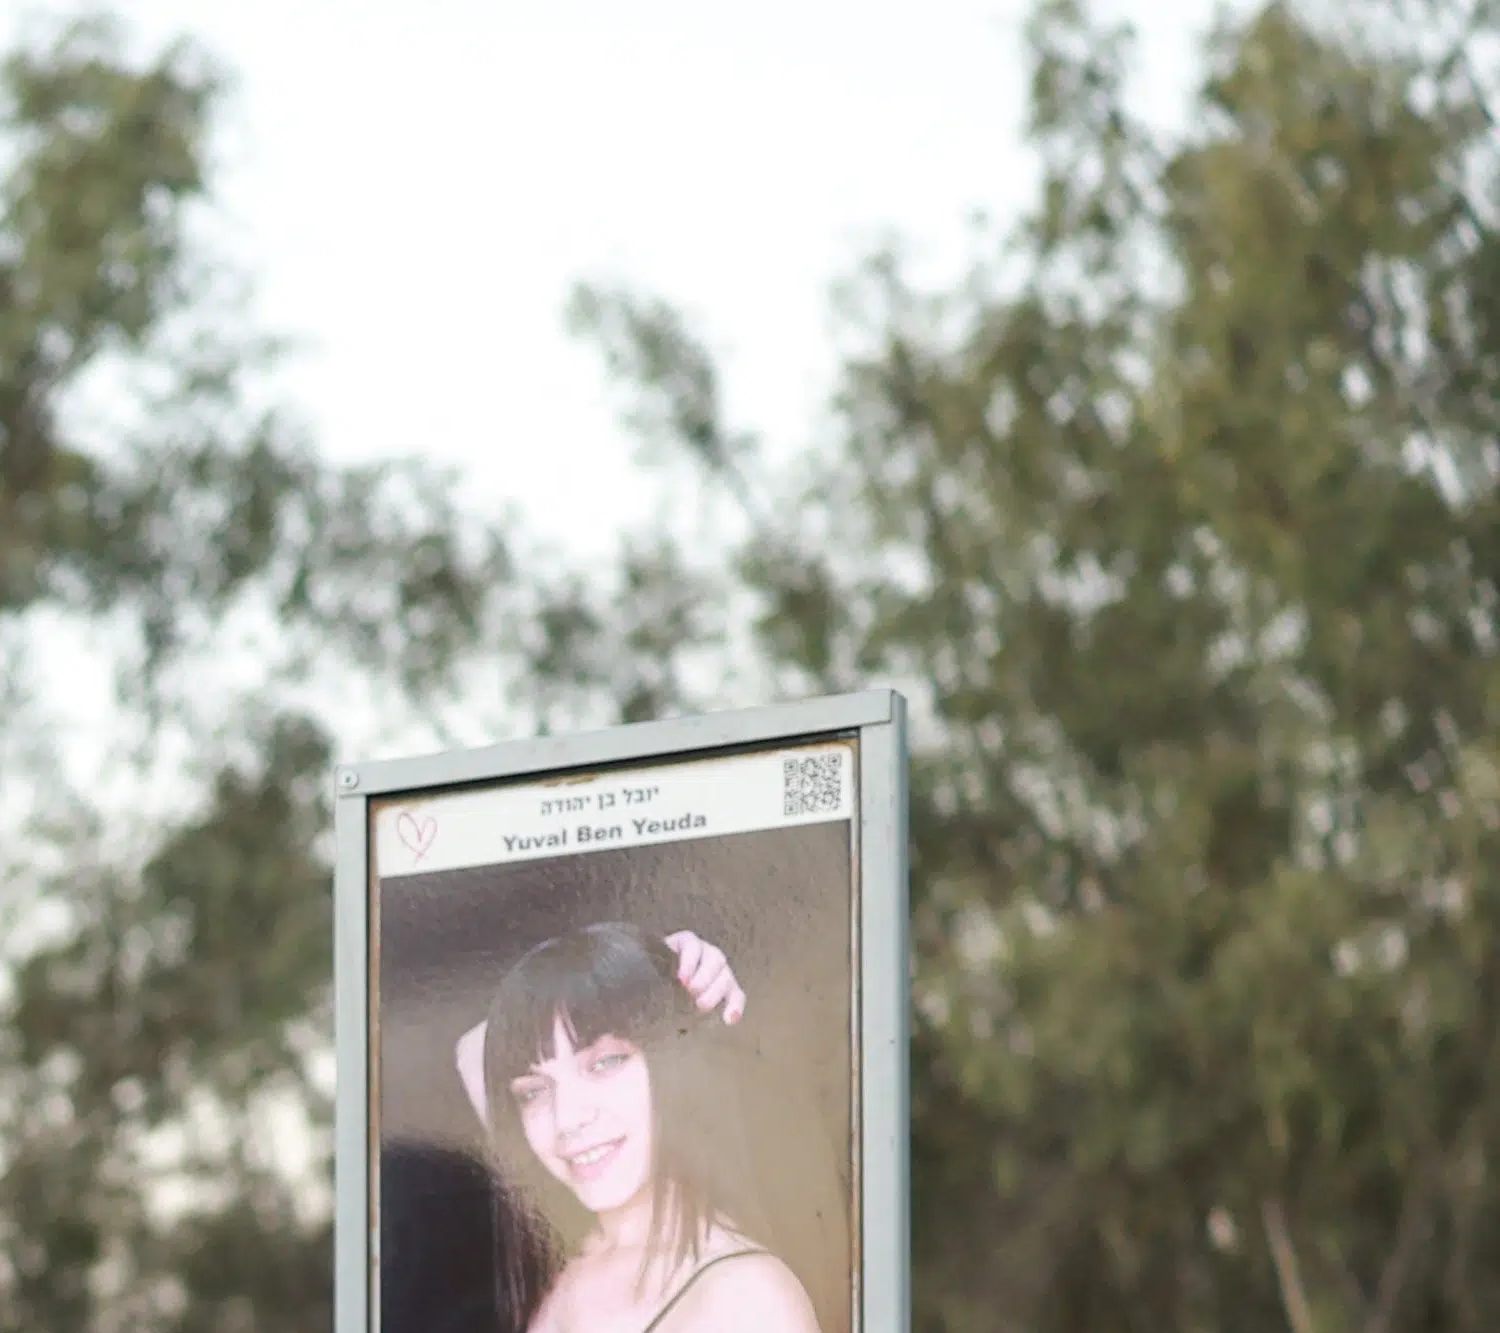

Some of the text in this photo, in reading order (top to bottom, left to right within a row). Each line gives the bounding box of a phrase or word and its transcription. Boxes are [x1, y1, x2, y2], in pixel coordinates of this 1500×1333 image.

[540, 785, 660, 817] יובל בן יהודה
[502, 813, 708, 854] Yuval Ben Yeuda
